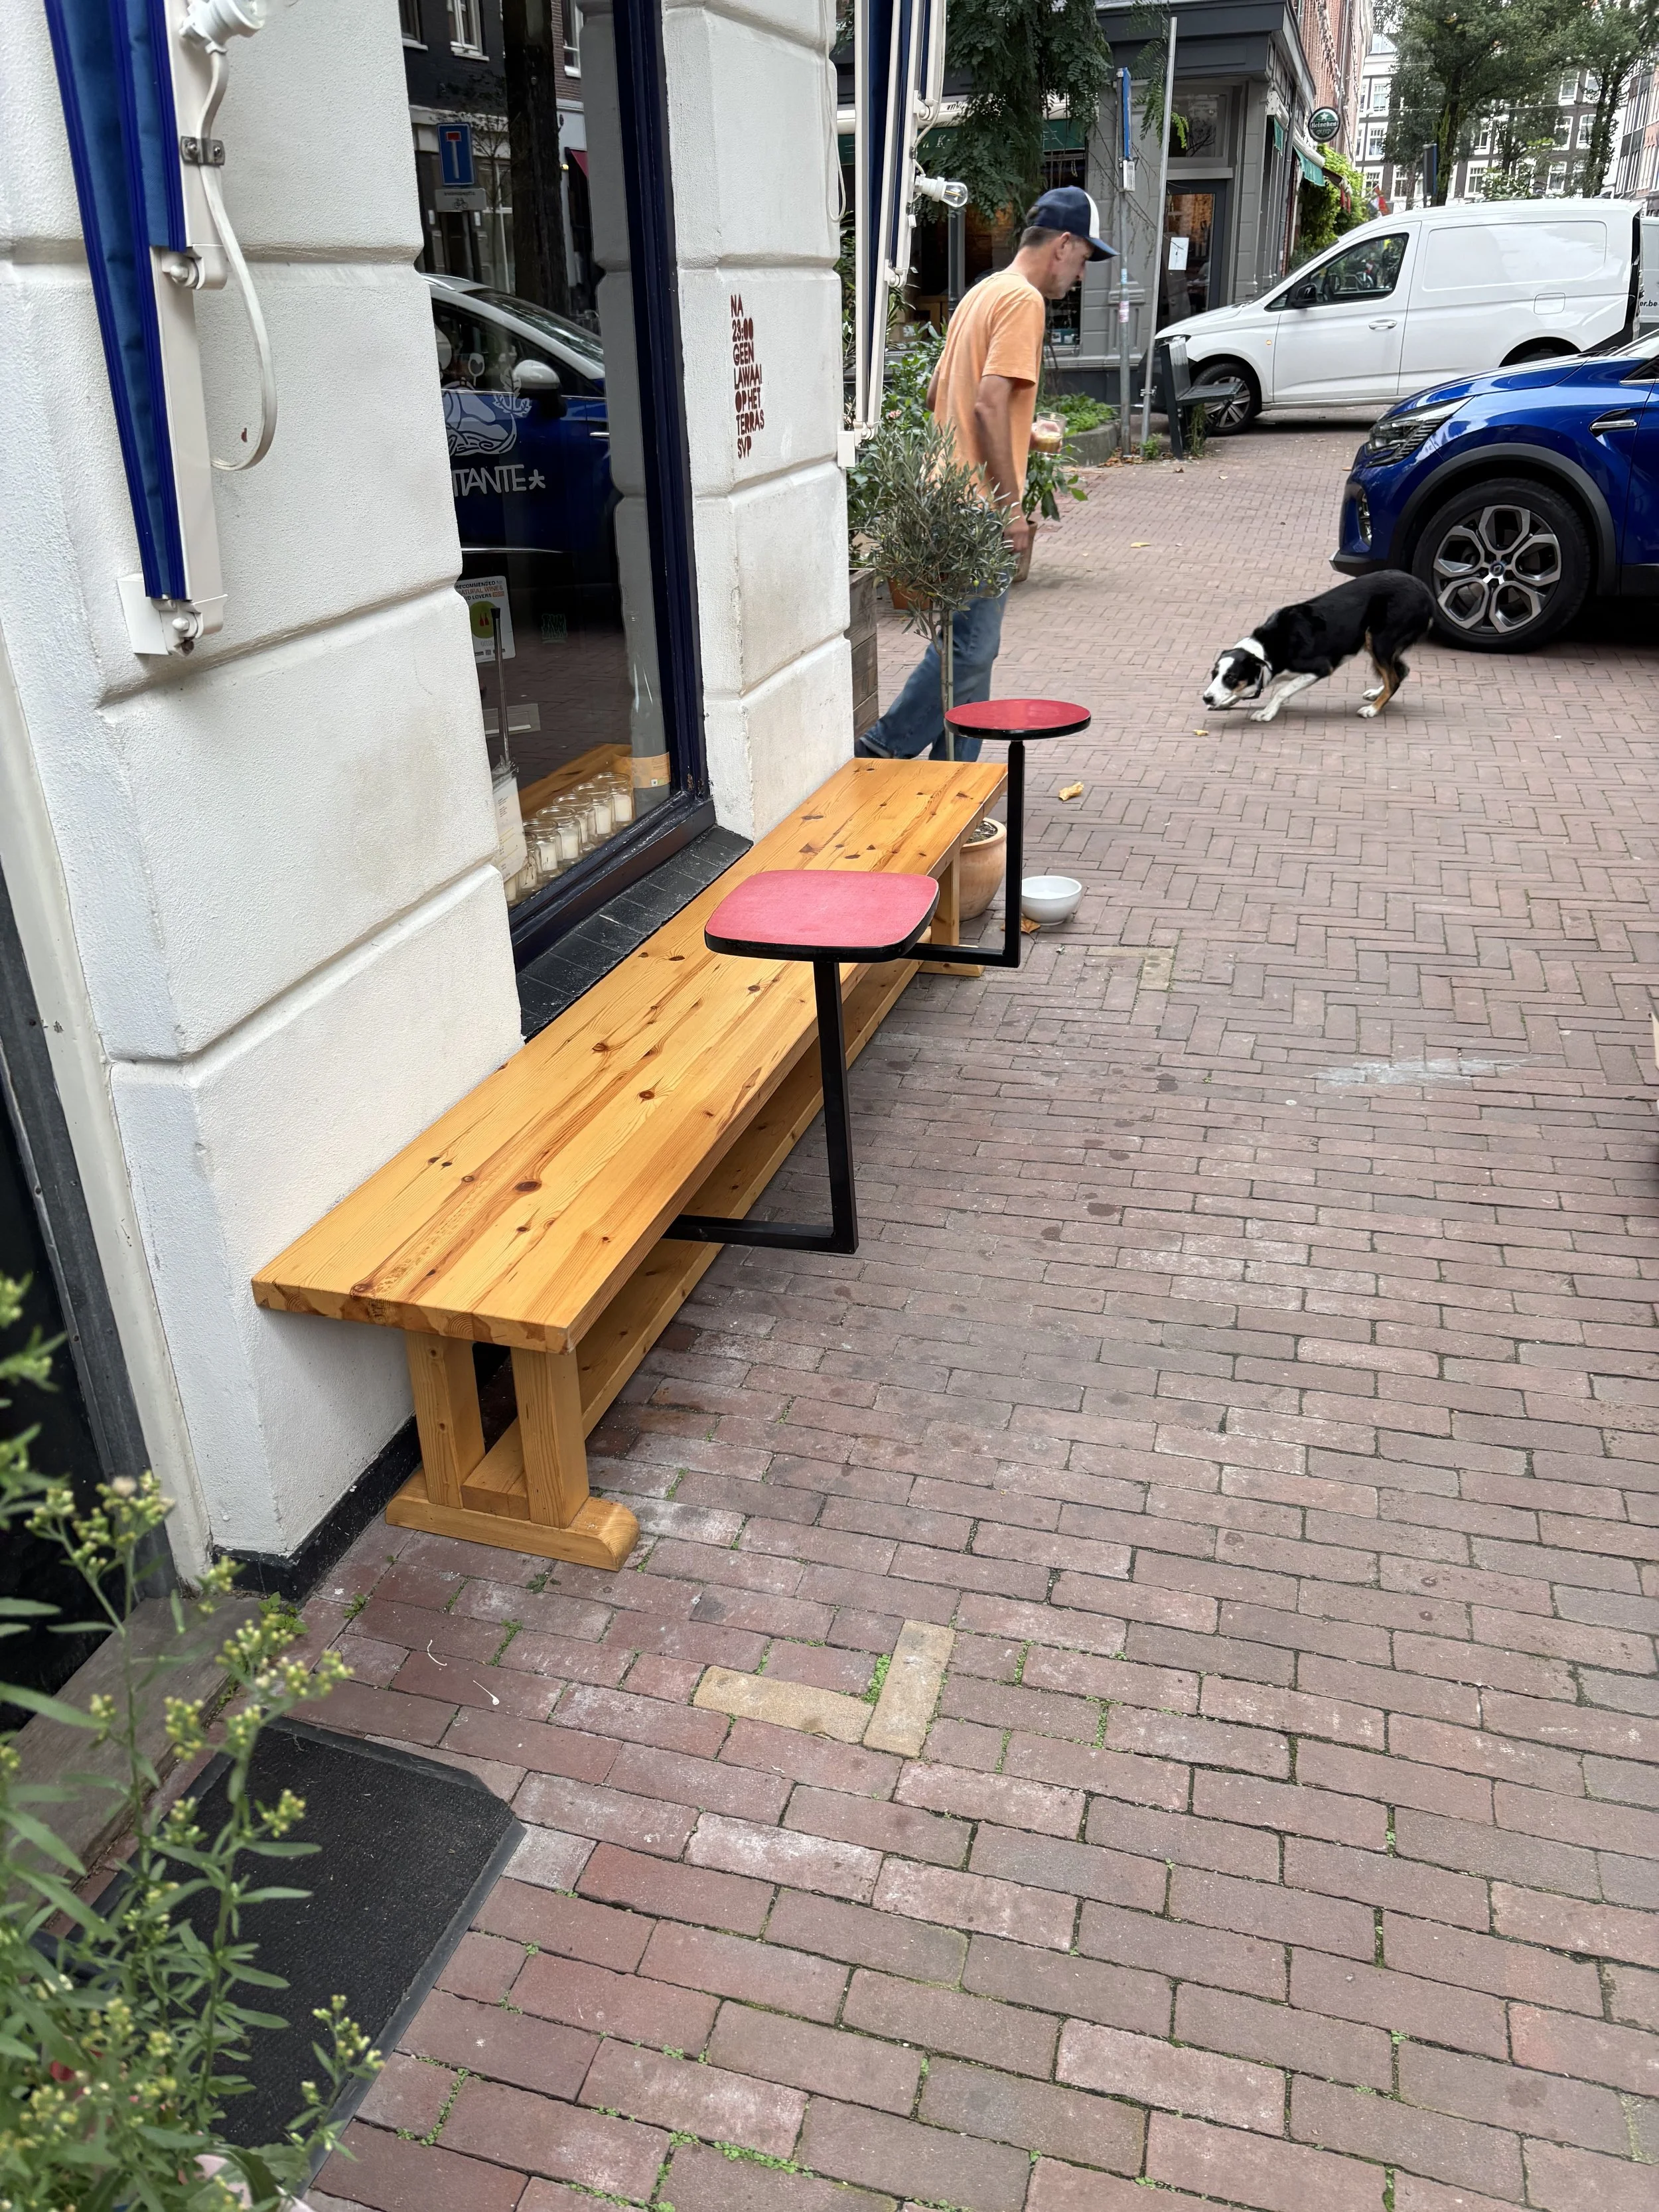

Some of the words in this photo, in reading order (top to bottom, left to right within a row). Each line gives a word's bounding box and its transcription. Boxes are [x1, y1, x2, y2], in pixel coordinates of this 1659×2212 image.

[731, 294, 743, 317] NA
[732, 318, 753, 342] 23:00
[733, 341, 754, 366] GEEN
[734, 364, 762, 390] LAWAAI
[735, 390, 746, 413] OP
[747, 387, 760, 409] HET
[736, 409, 764, 436] TERRAS
[737, 435, 751, 459] SVP
